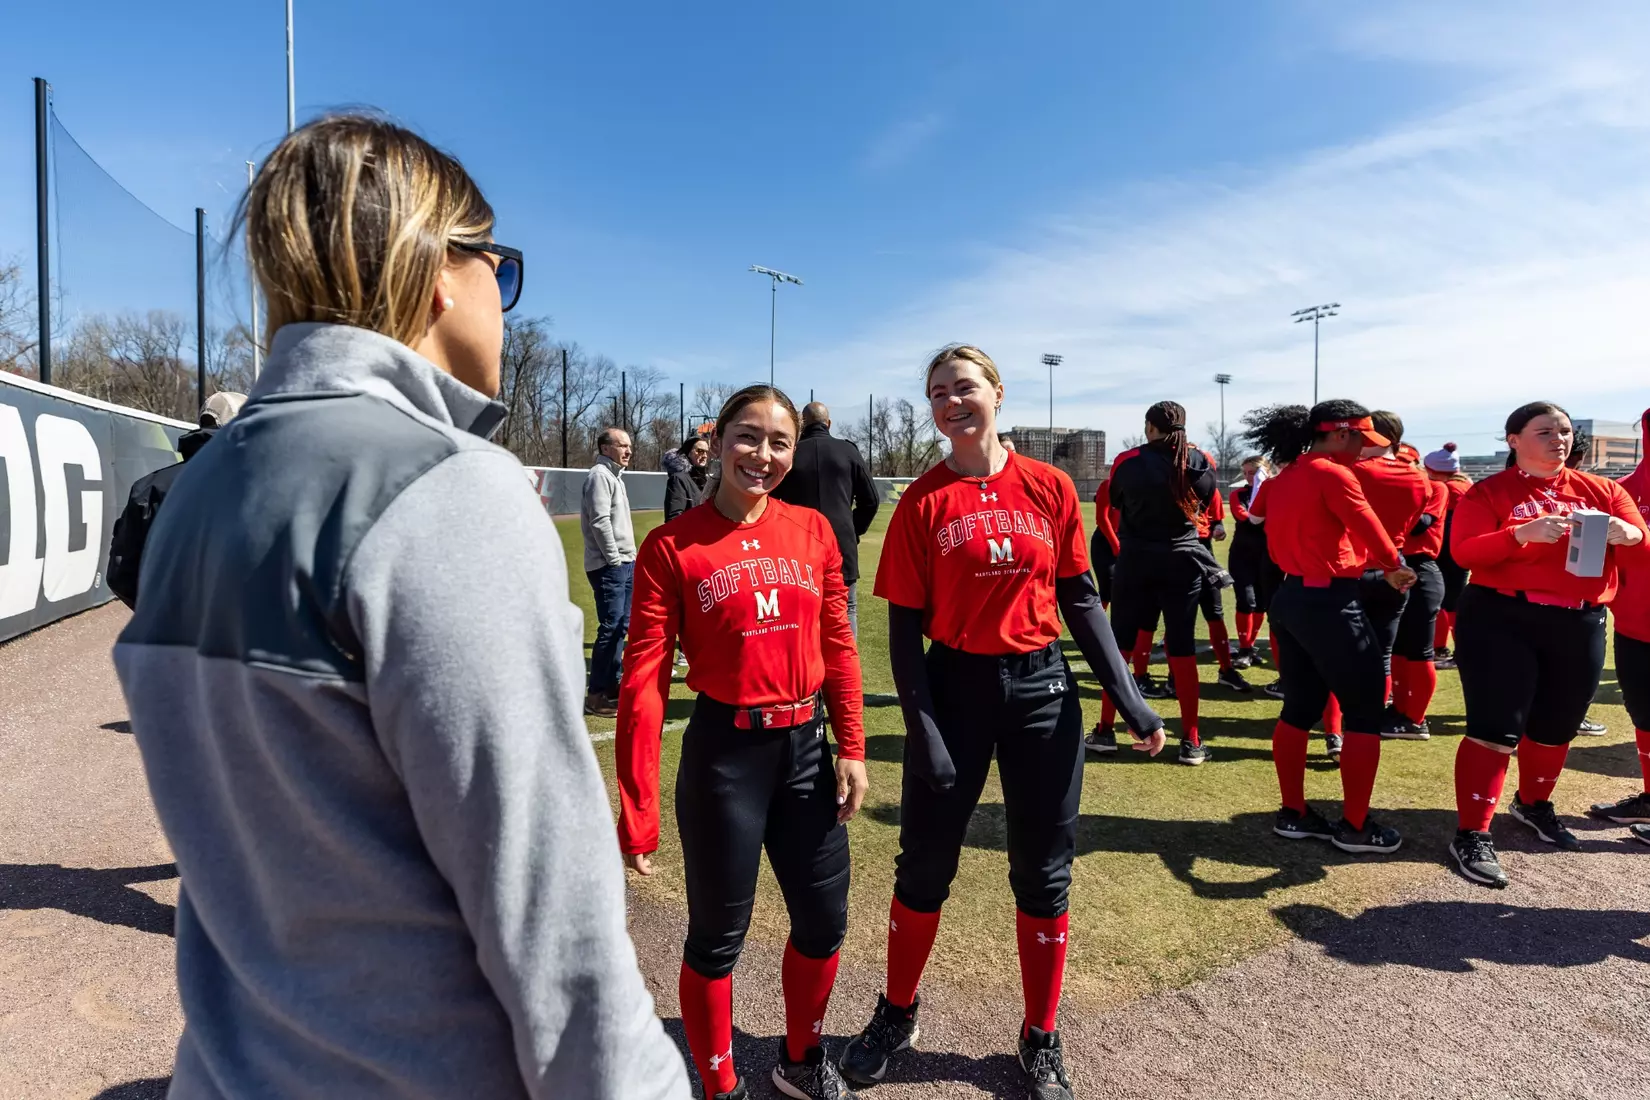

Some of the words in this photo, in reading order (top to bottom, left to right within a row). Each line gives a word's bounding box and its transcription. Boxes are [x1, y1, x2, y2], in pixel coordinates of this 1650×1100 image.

[937, 510, 1054, 556] SOFTBALL
[987, 536, 1015, 565] M
[697, 557, 820, 613] SOFTBALL
[754, 588, 781, 620] M
